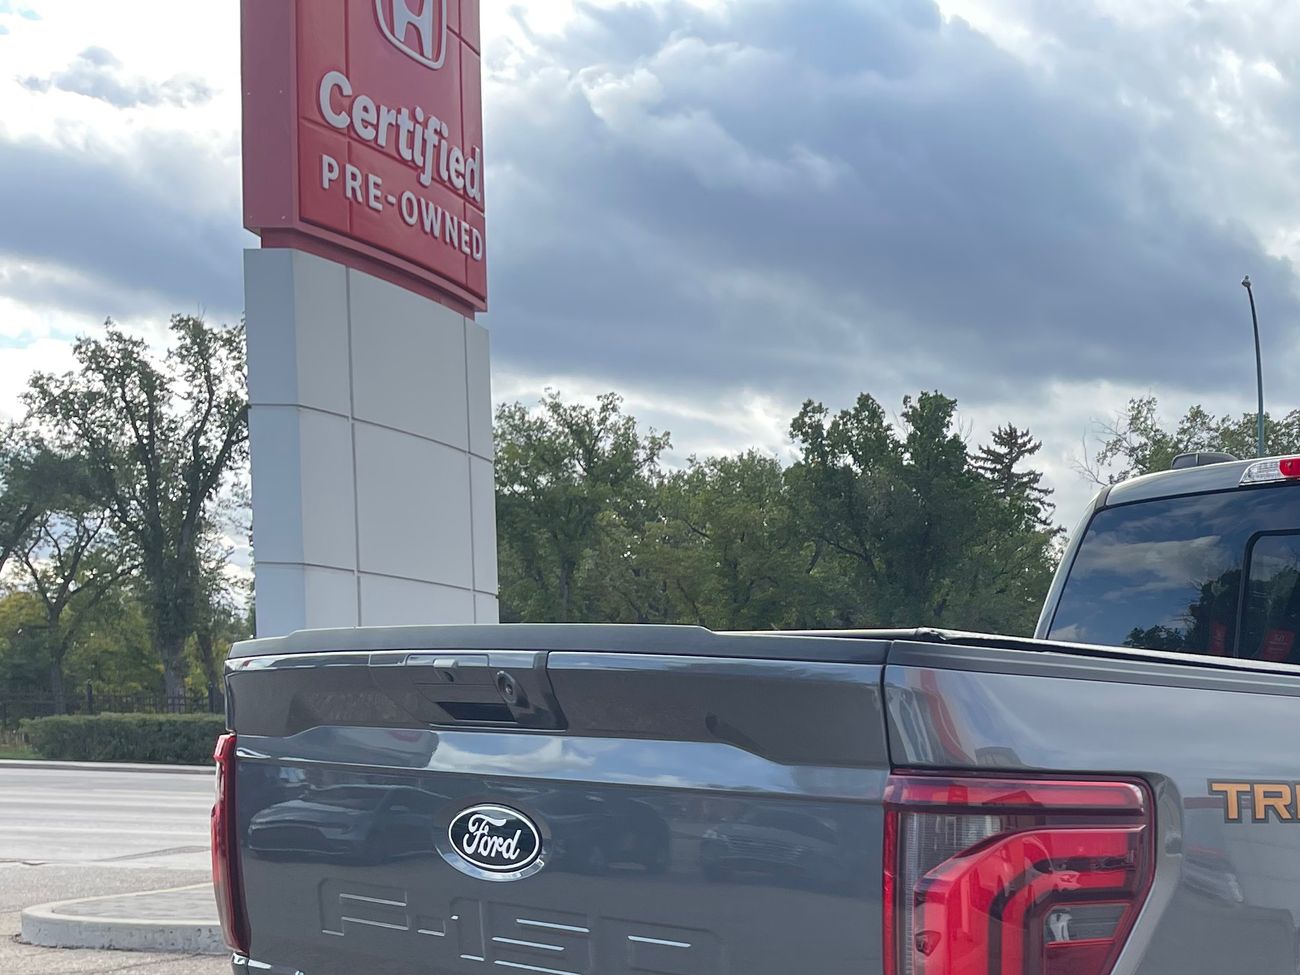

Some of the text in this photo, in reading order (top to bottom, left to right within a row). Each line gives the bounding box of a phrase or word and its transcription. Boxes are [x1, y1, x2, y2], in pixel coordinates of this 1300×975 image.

[319, 70, 481, 202] Certified
[321, 154, 483, 261] PRE-OWNED
[463, 814, 521, 860] Ford
